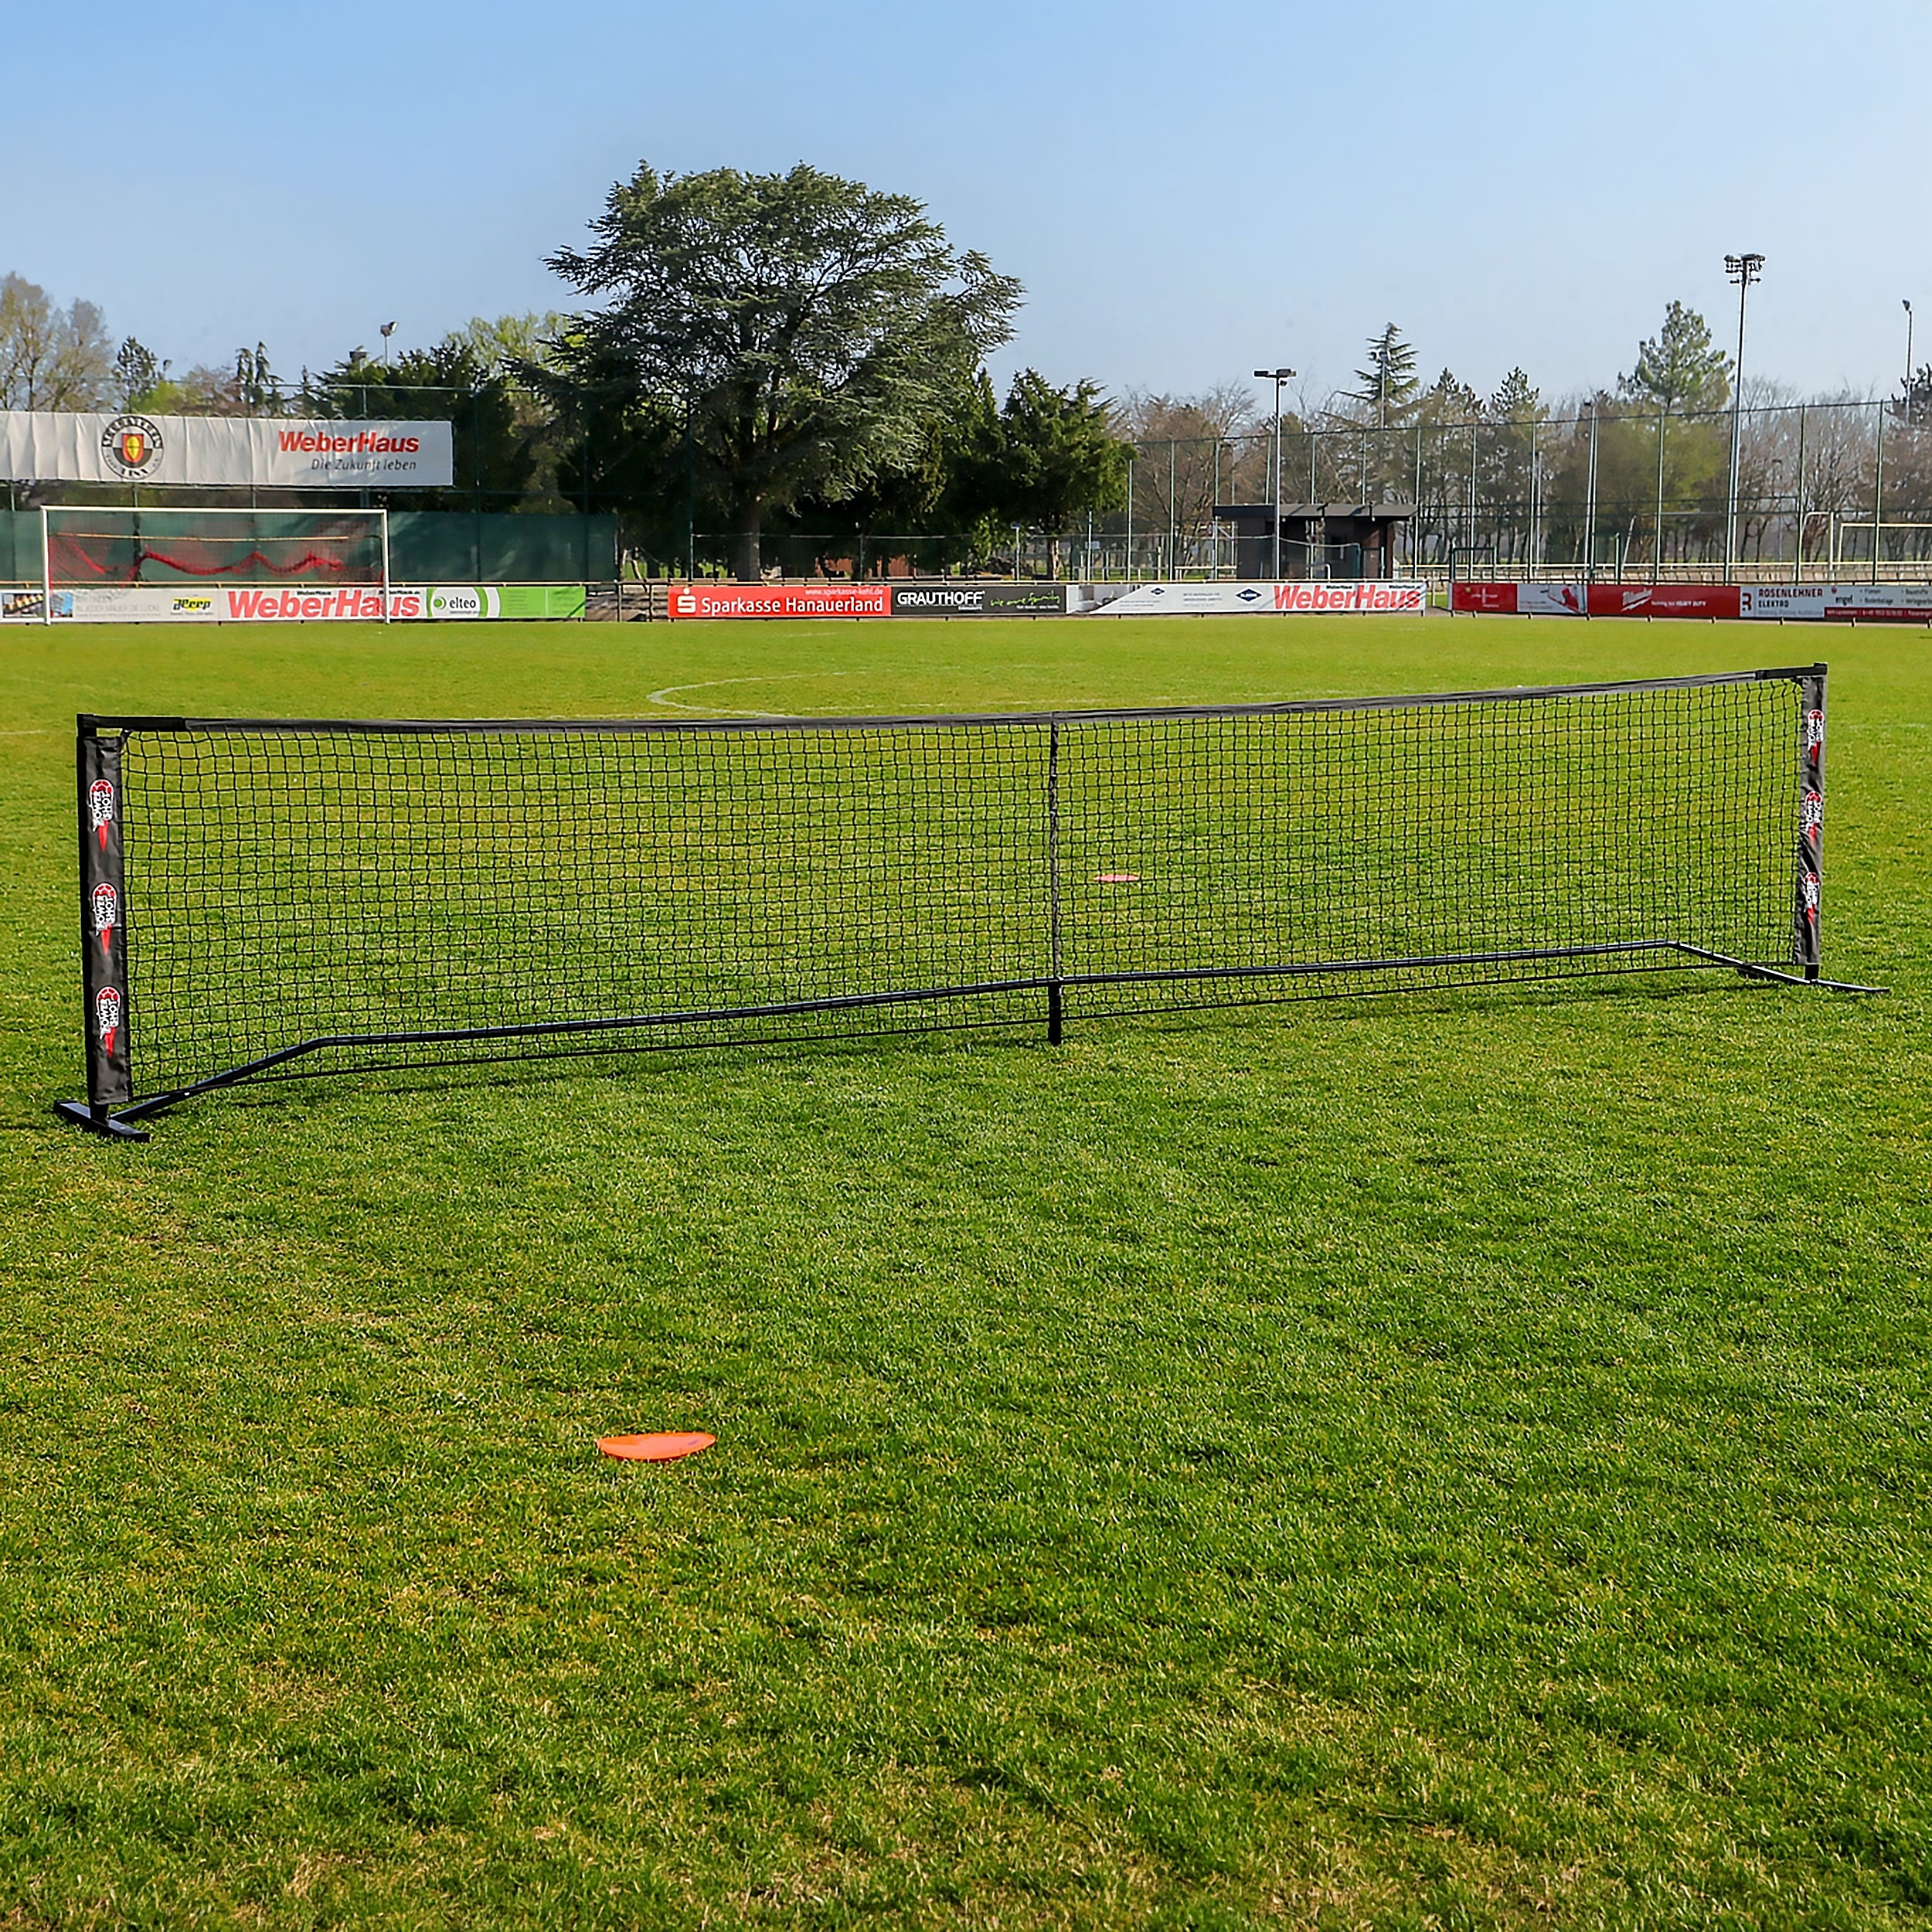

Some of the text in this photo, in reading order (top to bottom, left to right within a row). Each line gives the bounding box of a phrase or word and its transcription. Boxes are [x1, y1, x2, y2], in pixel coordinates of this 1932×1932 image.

[279, 431, 420, 453] WeberHaus
[311, 459, 417, 471] Die Zukunft leben
[896, 591, 982, 605] GRAUTHOFF
[1274, 584, 1420, 610] WeberHaus
[1758, 588, 1823, 597] ROSENLEHNER
[228, 590, 420, 617] WeberHaus
[449, 597, 476, 609] elteo
[701, 597, 883, 616] Sparkasse Hanauerland
[1758, 600, 1789, 608] ELEKTRO
[101, 791, 113, 820] SHOT
[105, 896, 116, 924] SHOT
[108, 1000, 119, 1028] SHOT
